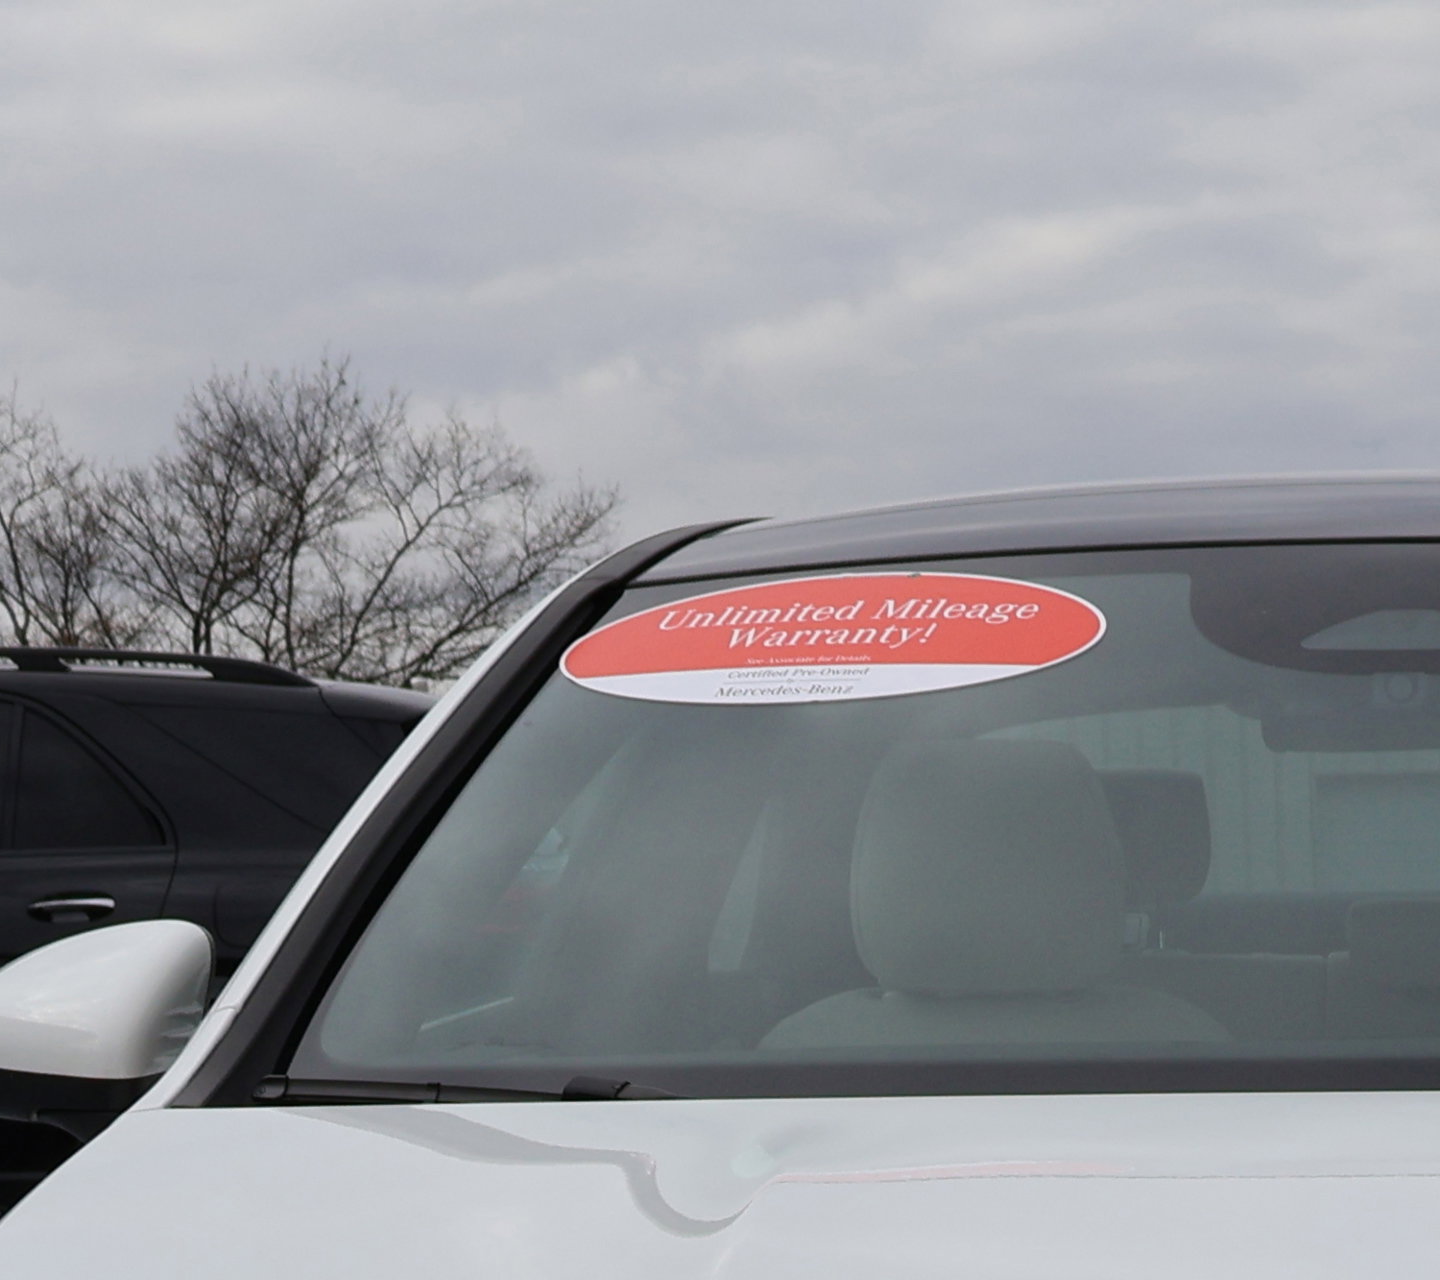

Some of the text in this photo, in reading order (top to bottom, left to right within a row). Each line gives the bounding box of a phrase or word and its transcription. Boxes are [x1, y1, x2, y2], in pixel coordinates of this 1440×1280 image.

[658, 598, 1040, 632] Unlimited Mileage
[727, 622, 938, 650] Warranty!
[727, 666, 870, 680] Certified Pre-Owned
[714, 683, 855, 699] Mercedes-Benz
